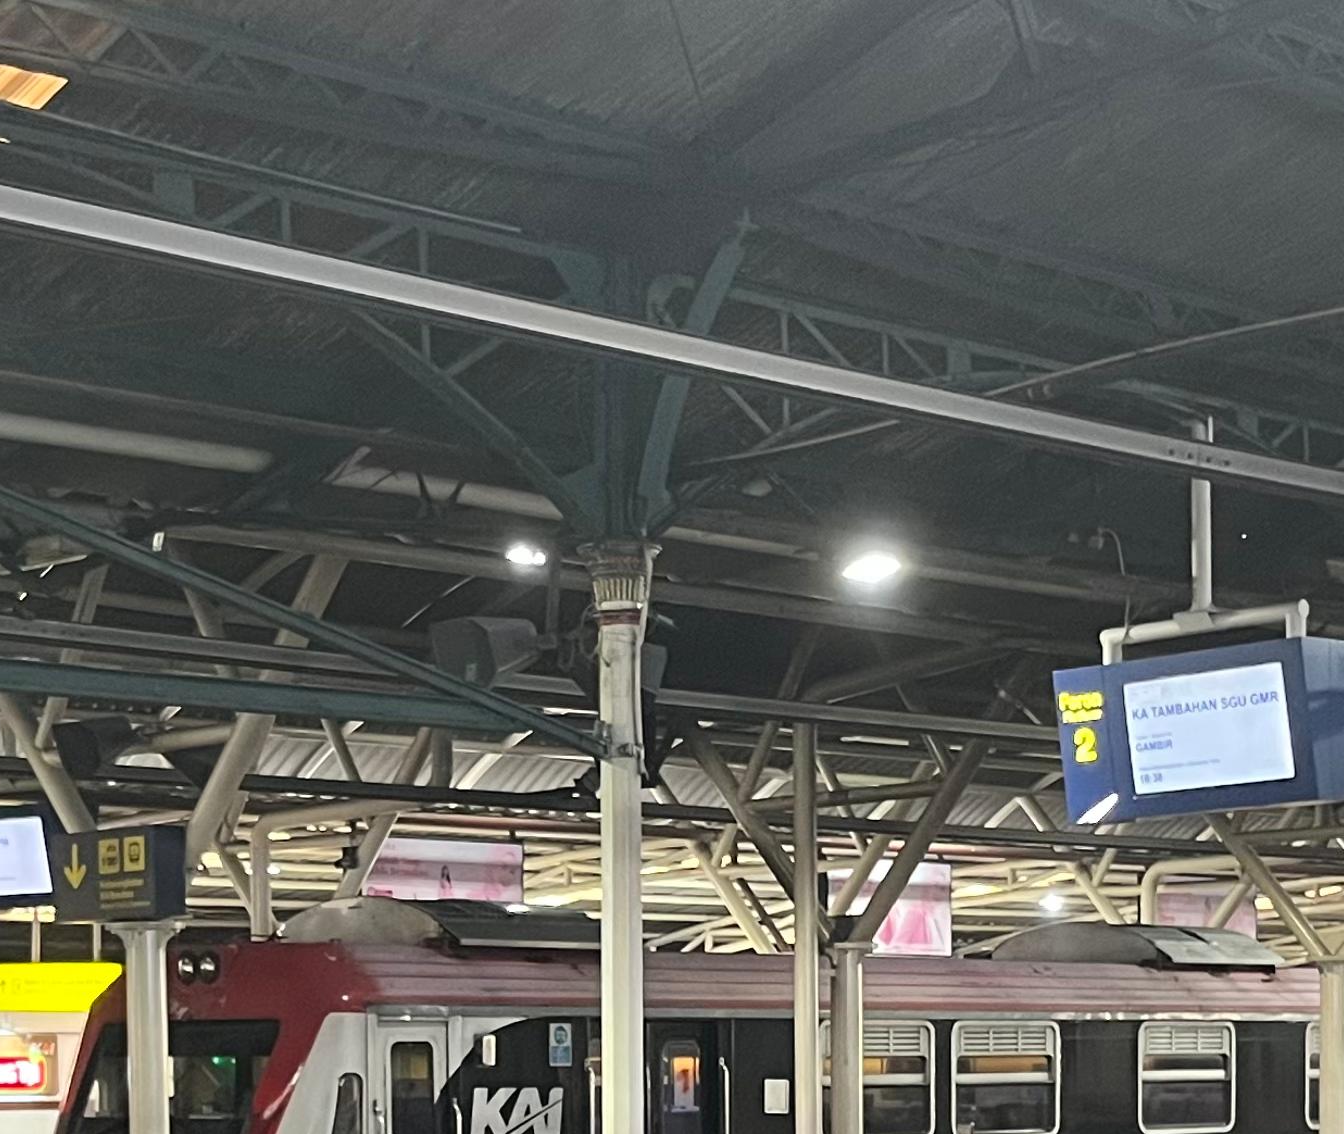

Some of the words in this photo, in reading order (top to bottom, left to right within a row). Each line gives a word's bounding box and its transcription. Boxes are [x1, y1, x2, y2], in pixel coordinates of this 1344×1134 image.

[1132, 708, 1148, 721] KA
[1152, 697, 1218, 719] TAMBAHAN
[1073, 726, 1098, 763] 2
